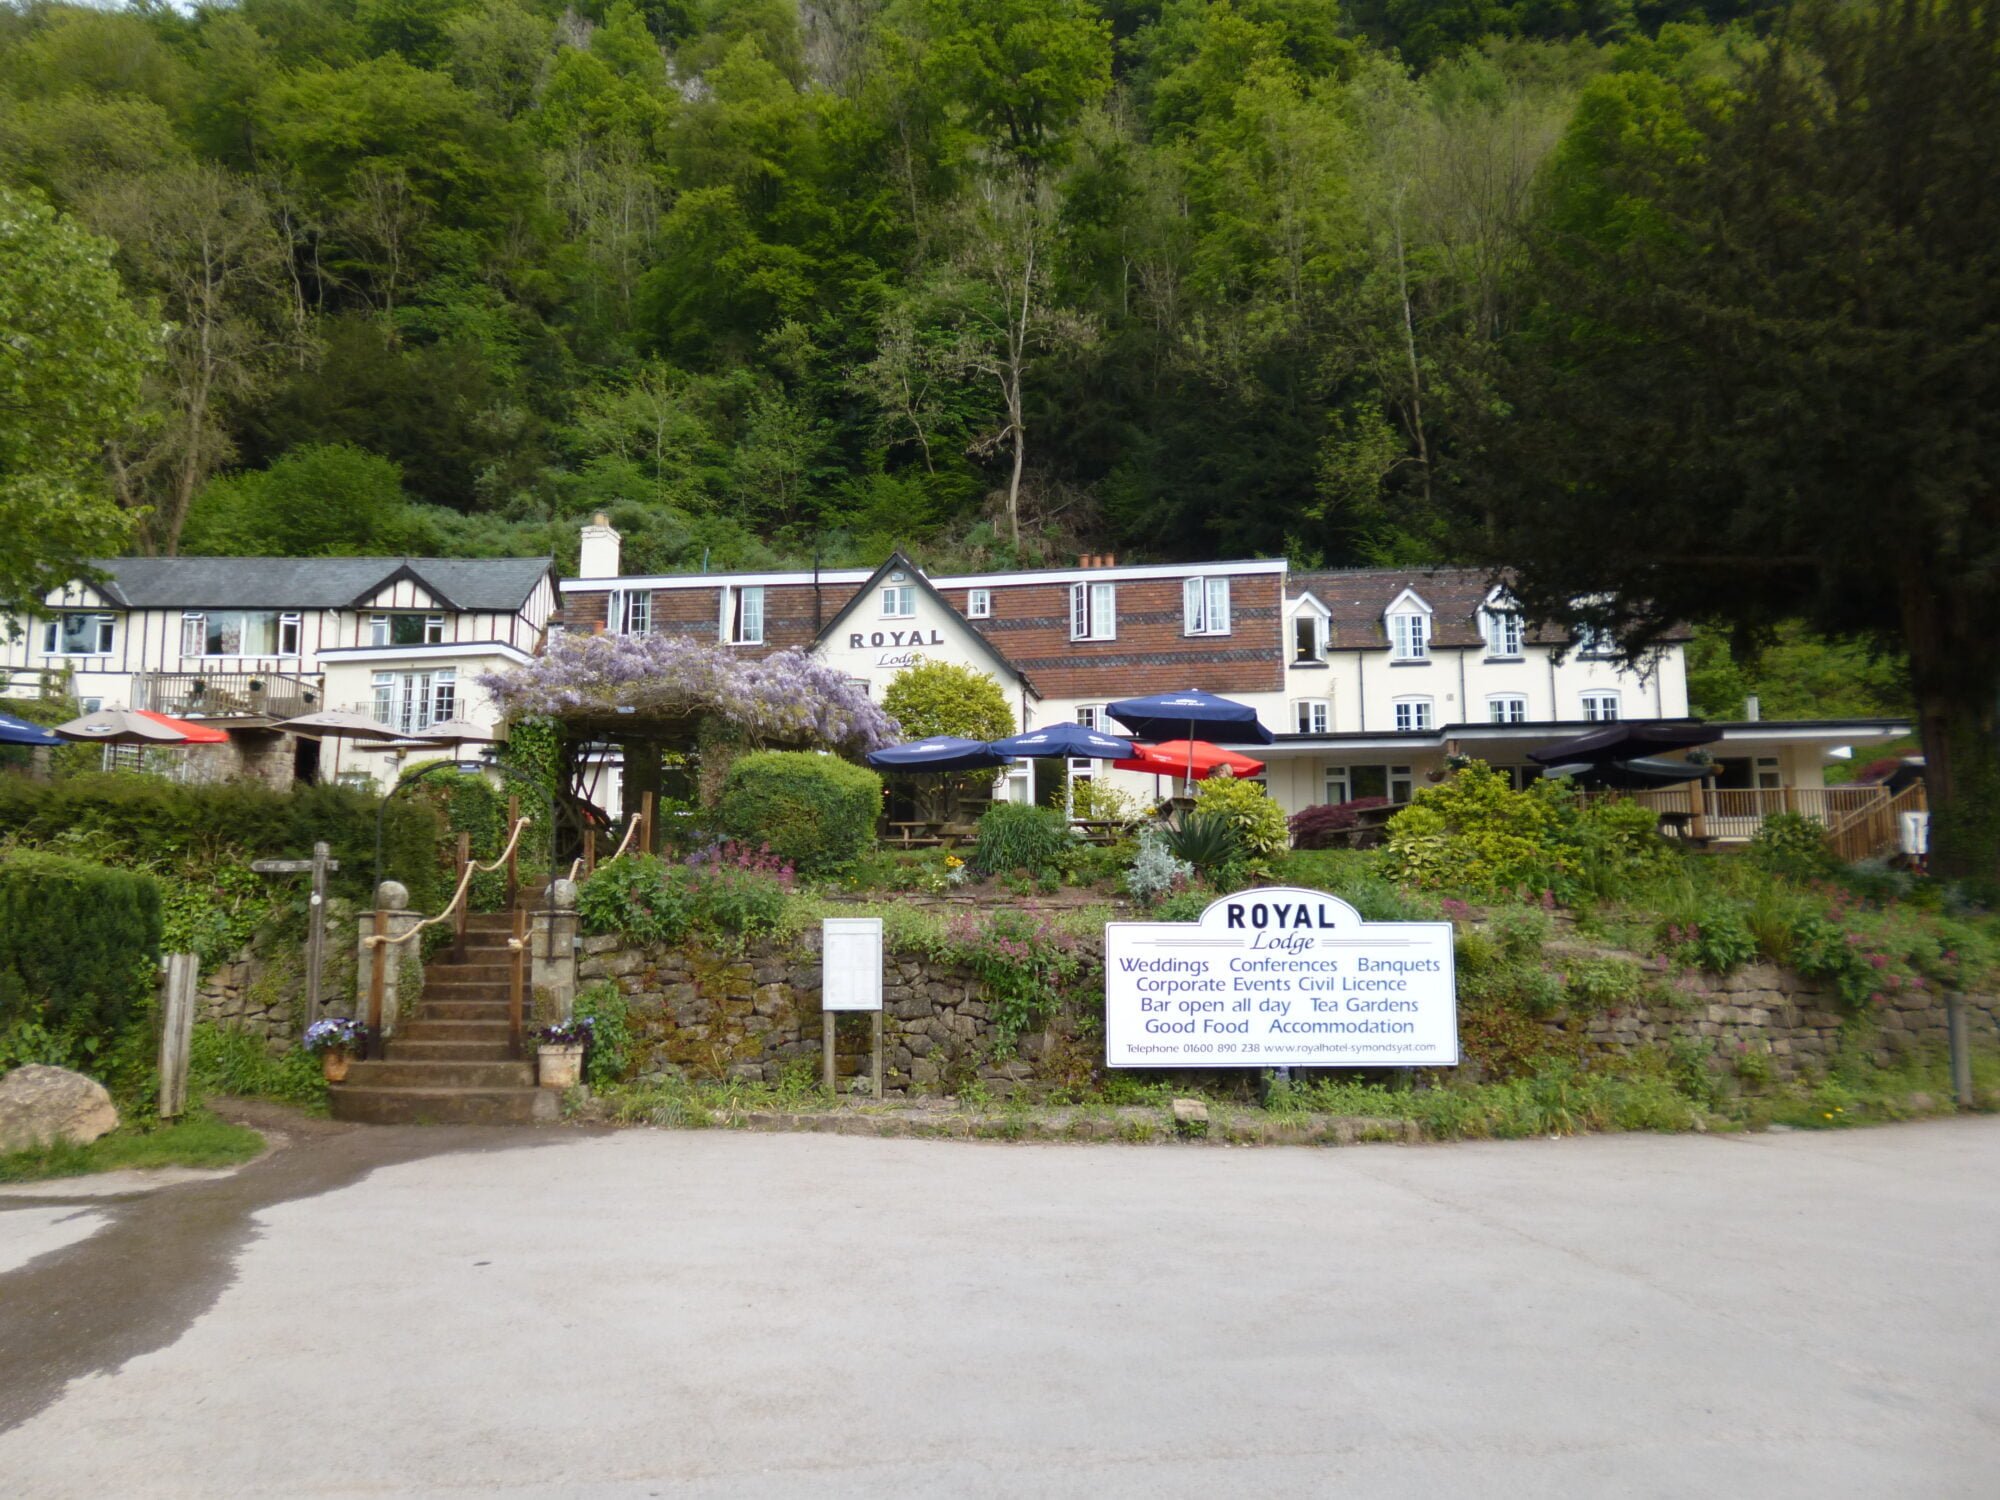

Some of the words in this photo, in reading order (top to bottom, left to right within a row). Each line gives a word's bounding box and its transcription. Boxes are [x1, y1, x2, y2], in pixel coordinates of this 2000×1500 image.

[850, 630, 944, 648] ROYAL
[877, 652, 925, 667] Lodg
[1227, 903, 1336, 929] ROYAL
[1250, 931, 1314, 955] Lodge
[1119, 958, 1209, 976] Weddings
[1229, 957, 1338, 973] Conferences
[1358, 957, 1440, 976] Banquets
[1136, 977, 1226, 996] Corporate
[1234, 977, 1291, 992] Events
[1298, 976, 1335, 992] Civil
[1342, 976, 1407, 992] Licence
[1141, 998, 1171, 1012] Bar
[1178, 1001, 1224, 1017] open
[1232, 998, 1251, 1012] all
[1259, 998, 1291, 1017] day
[1310, 997, 1338, 1012] Tea
[1346, 997, 1418, 1012] Gardens
[1145, 1019, 1195, 1034] Good
[1203, 1018, 1249, 1034] Food
[1268, 1018, 1414, 1034] Accommodation
[1127, 1044, 1179, 1055] Telephone
[1183, 1043, 1214, 1053] 01600
[1217, 1043, 1237, 1053] 890
[1241, 1043, 1260, 1053] 238
[1264, 1043, 1437, 1055] www.royalhotel-symondsyat.com
